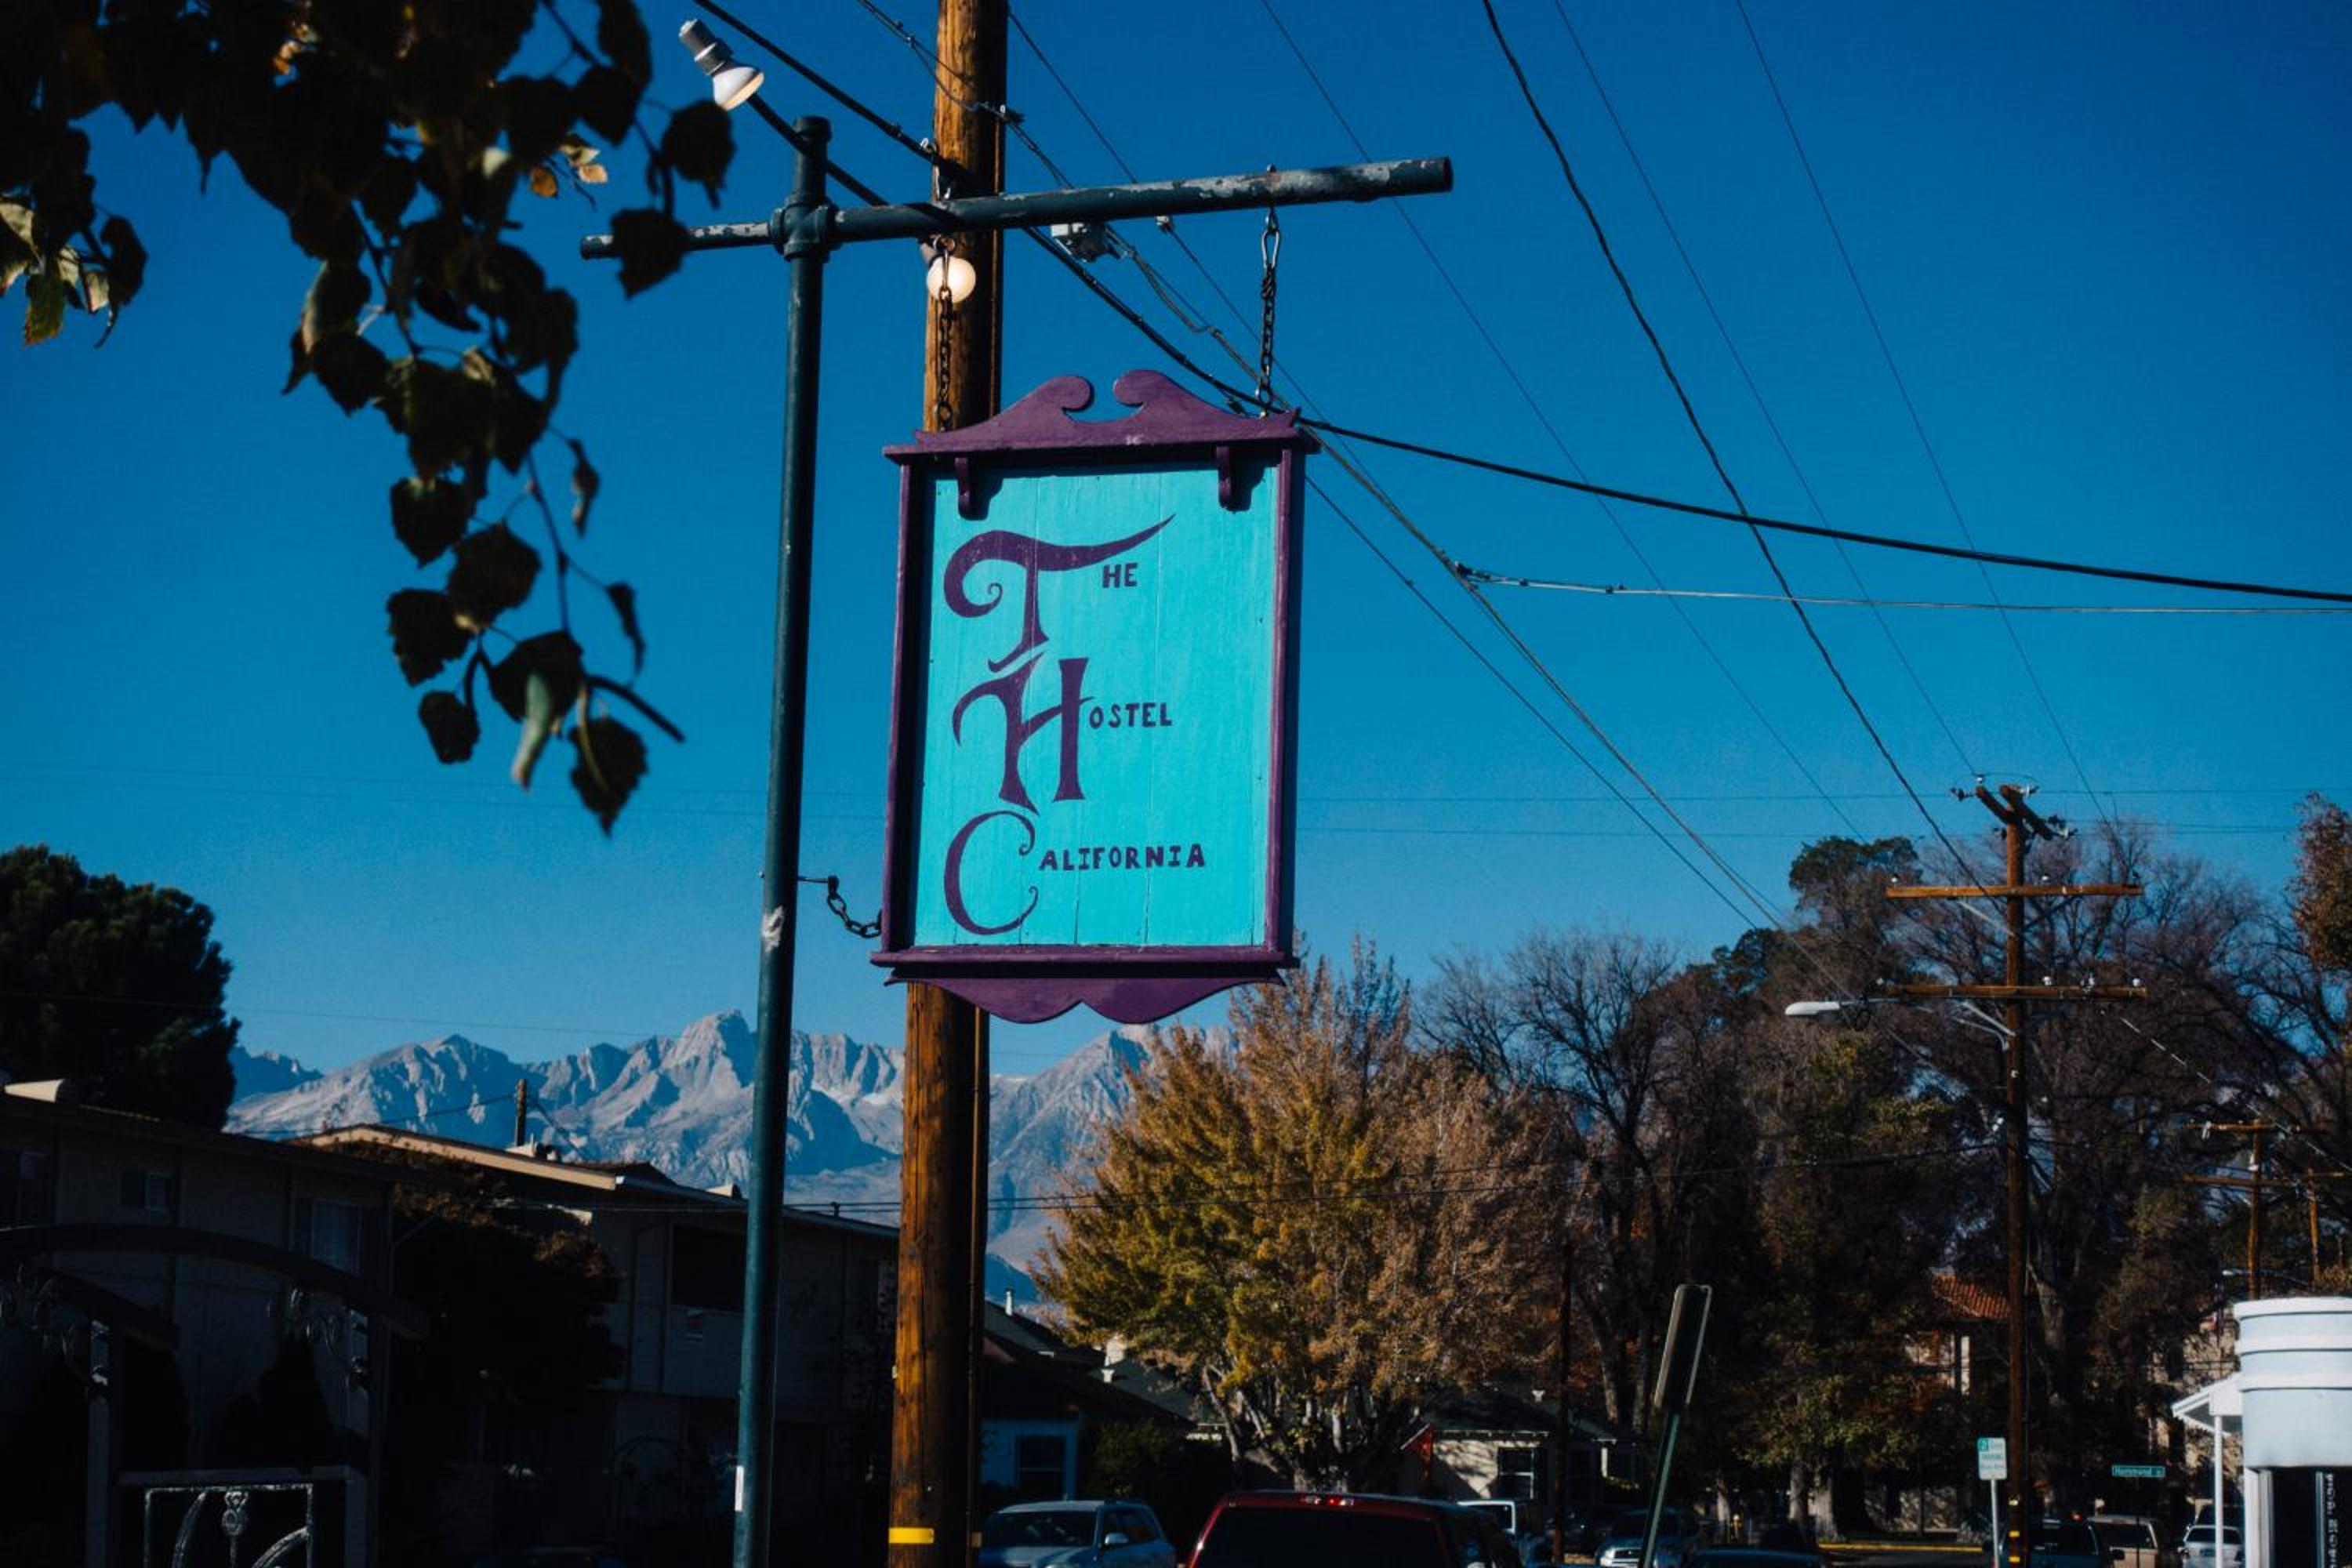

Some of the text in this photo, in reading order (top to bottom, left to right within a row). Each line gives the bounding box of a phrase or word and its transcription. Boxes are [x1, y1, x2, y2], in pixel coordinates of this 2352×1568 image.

[943, 514, 1176, 673] THE
[953, 651, 1173, 816] HOSTEL
[944, 810, 1205, 935] CALIFORNIA
